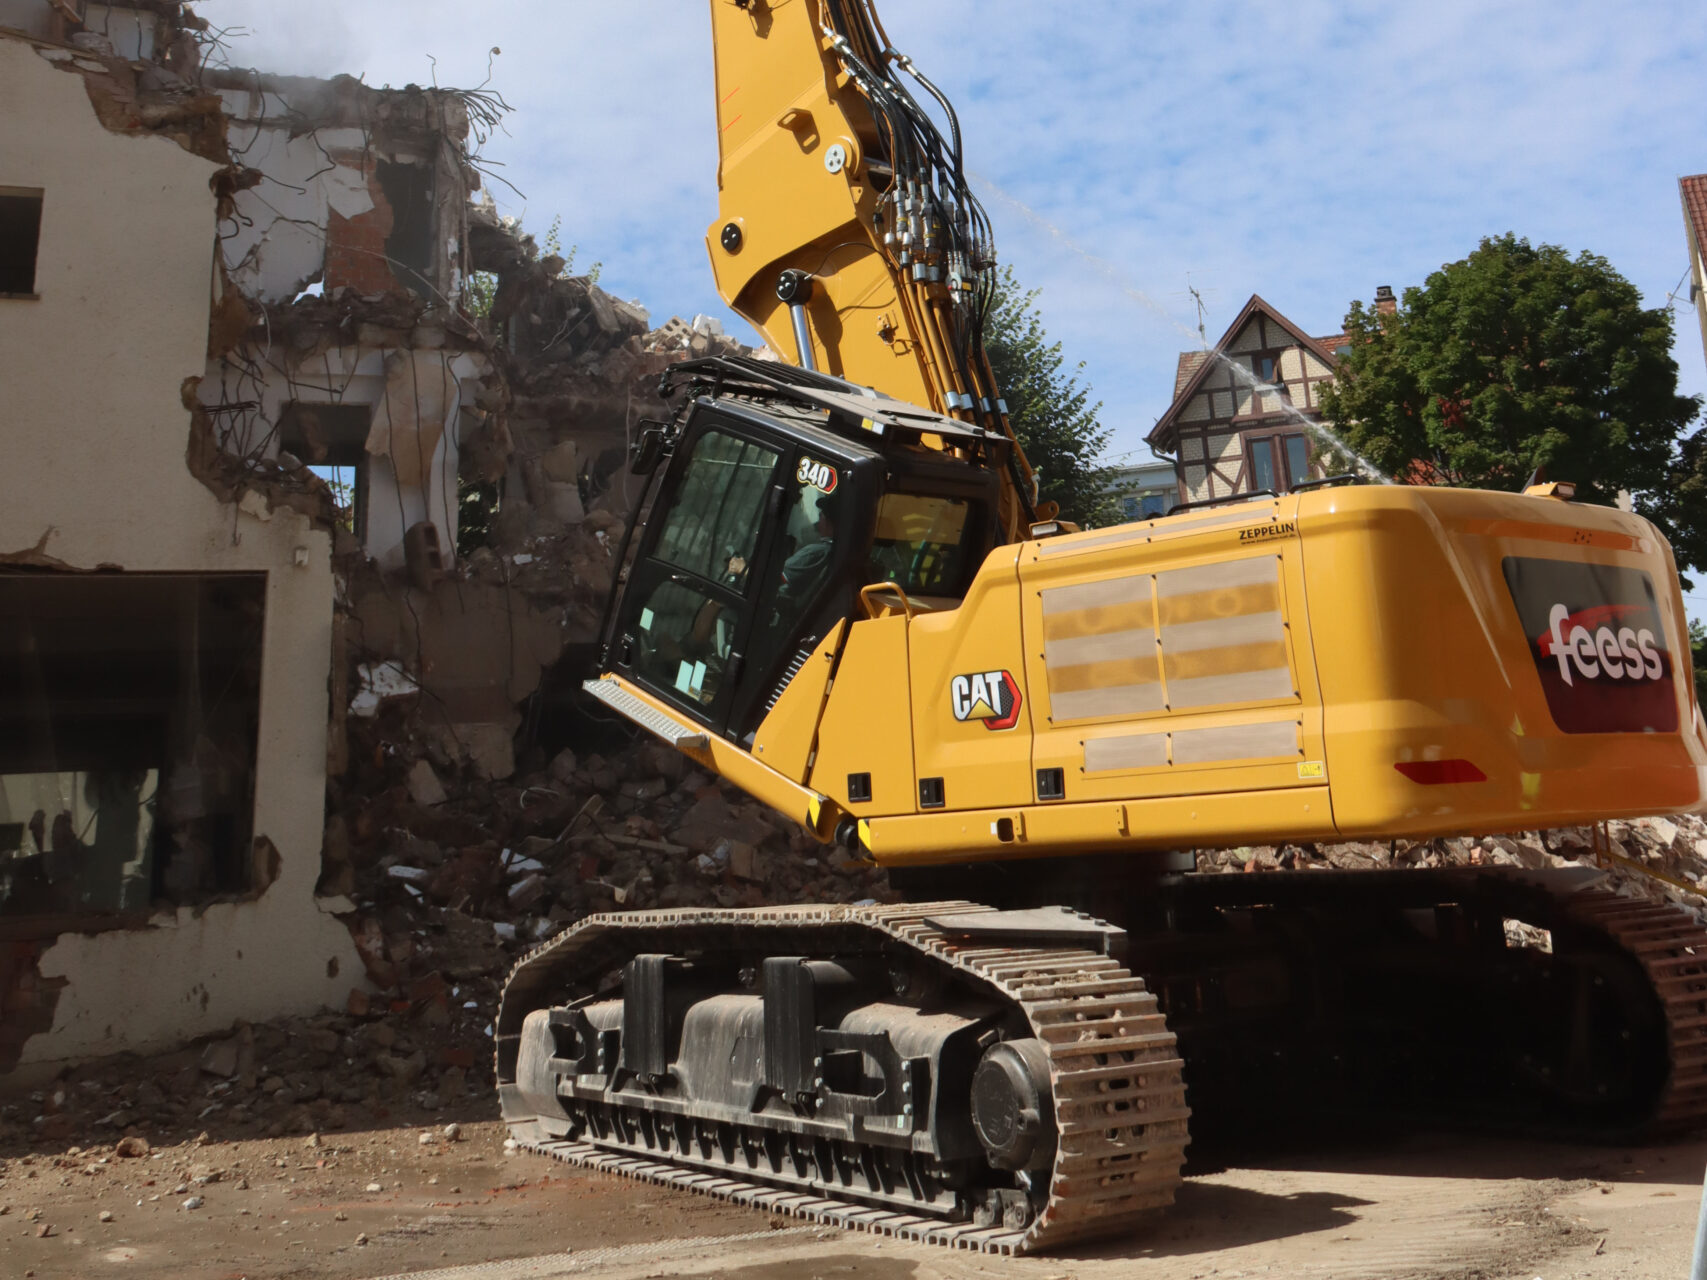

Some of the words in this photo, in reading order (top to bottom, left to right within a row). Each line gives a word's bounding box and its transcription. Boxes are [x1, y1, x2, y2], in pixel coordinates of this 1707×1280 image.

[799, 458, 830, 489] 340
[1239, 522, 1295, 540] ZEPPELIN
[1548, 603, 1663, 688] feess
[951, 671, 1003, 721] CAT
